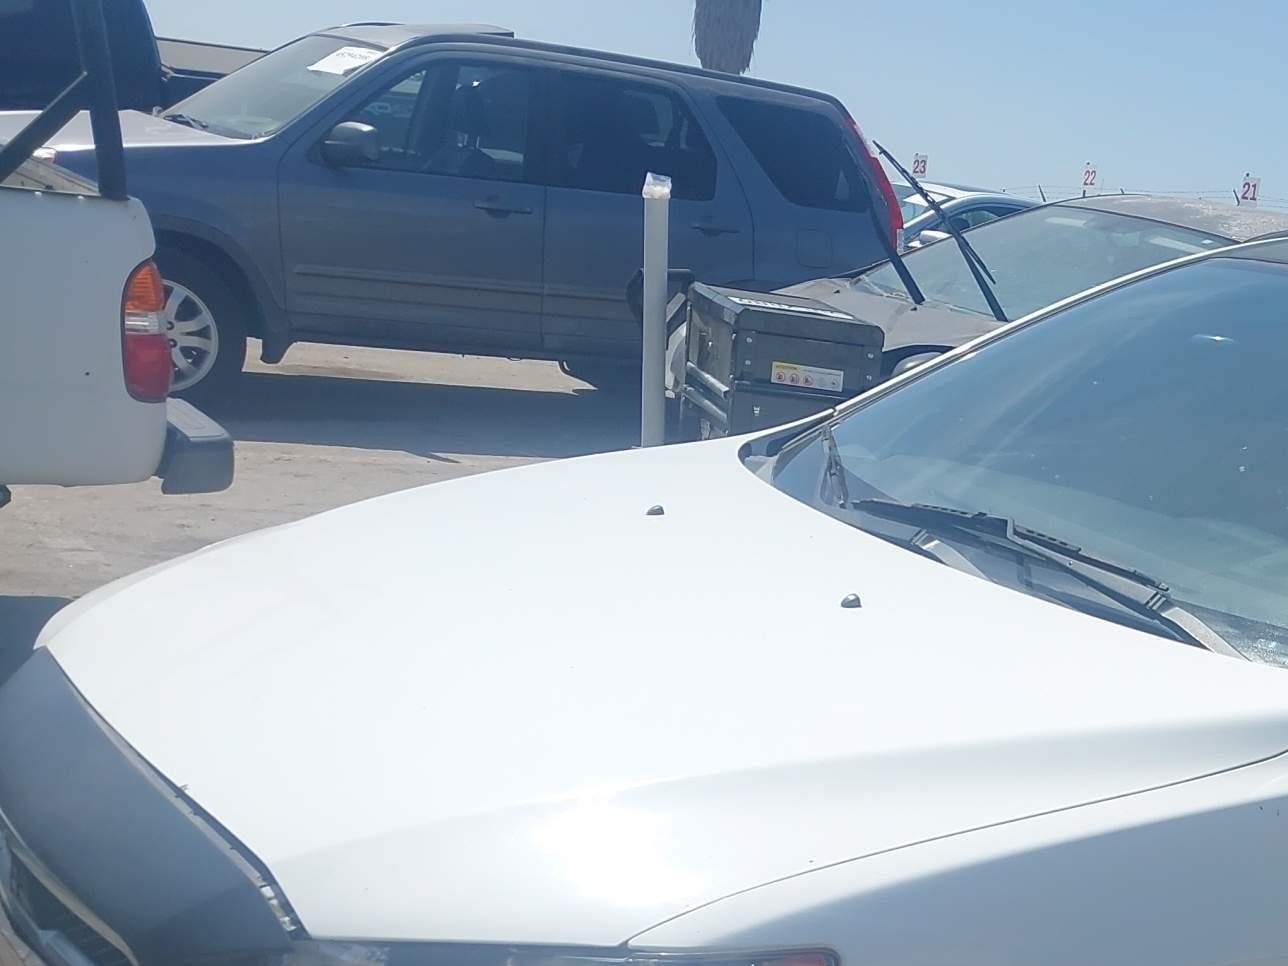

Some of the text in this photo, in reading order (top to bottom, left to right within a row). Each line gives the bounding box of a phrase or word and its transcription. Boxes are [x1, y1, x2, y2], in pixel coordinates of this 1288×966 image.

[912, 159, 927, 174] 23
[1083, 169, 1097, 186] 22
[1241, 181, 1257, 201] 21
